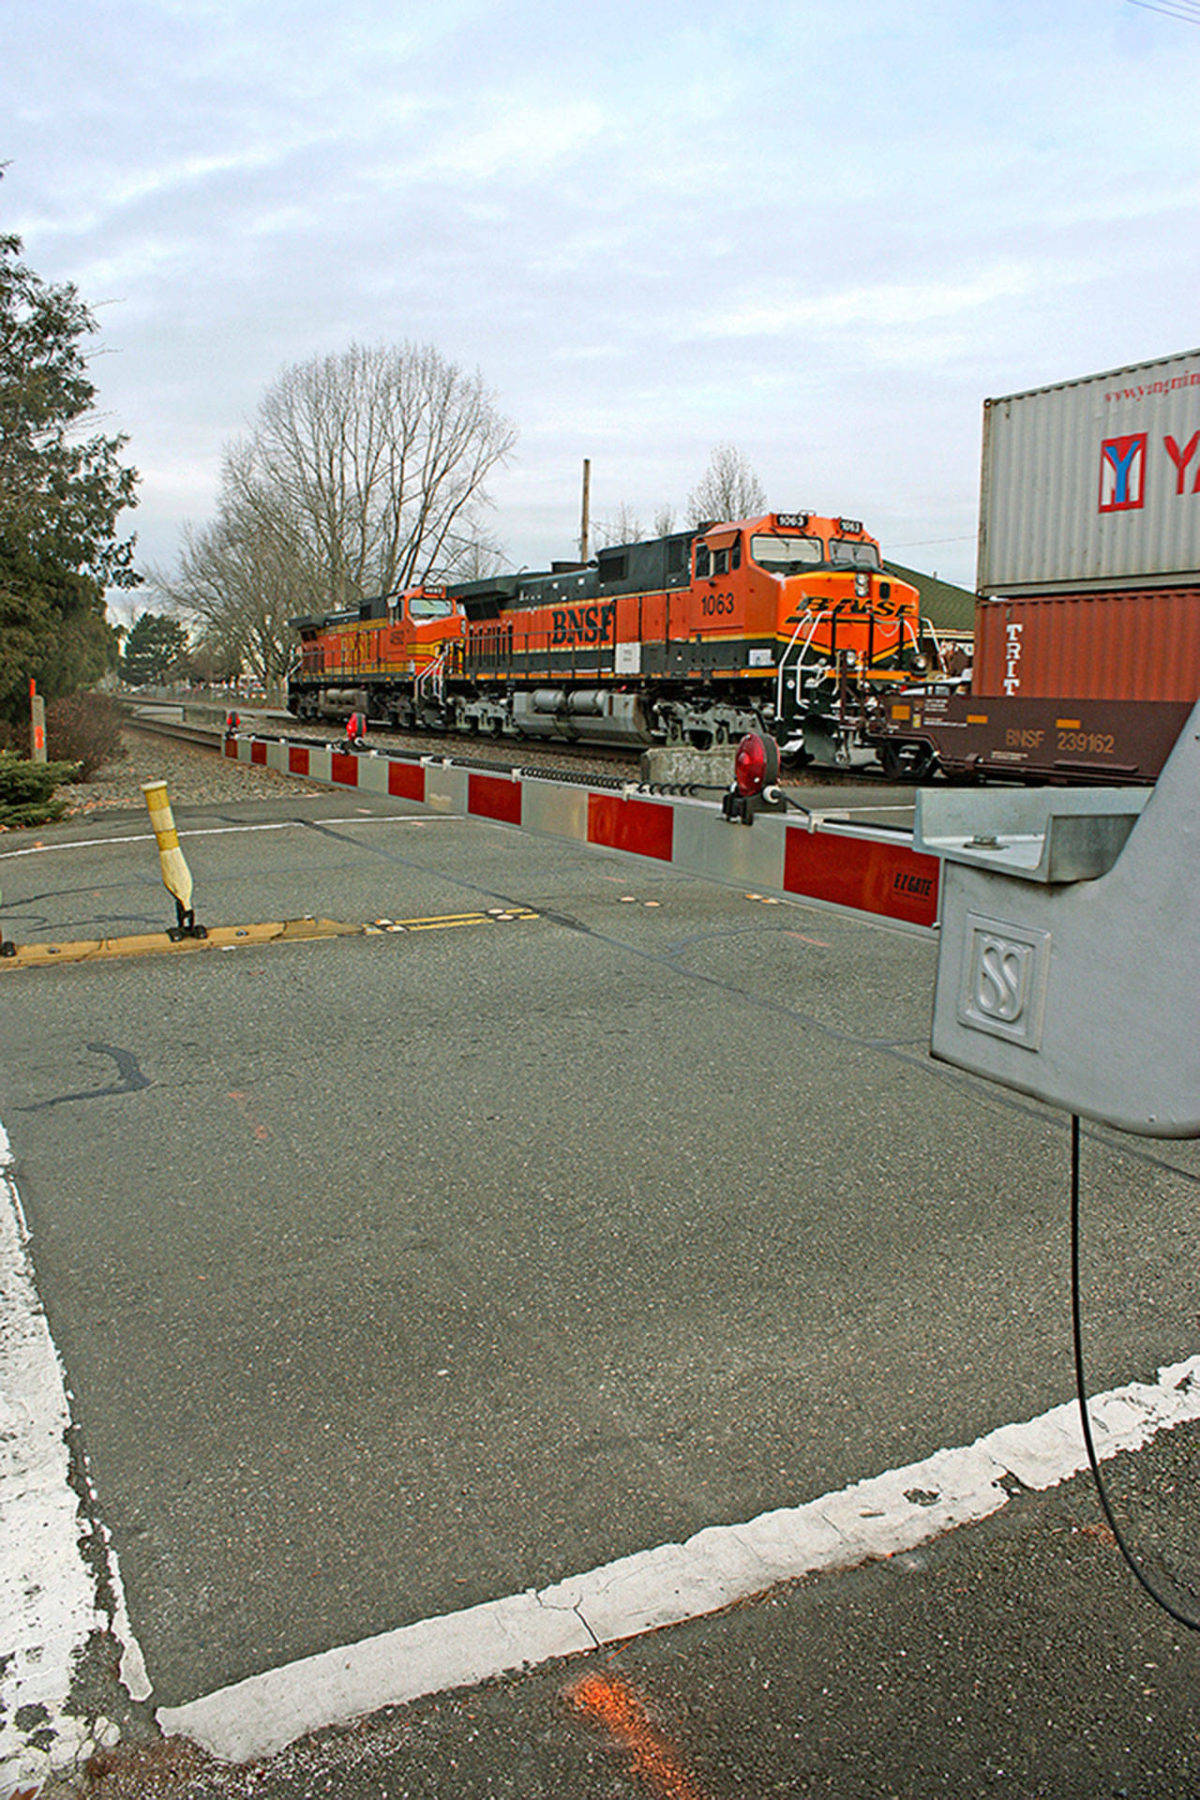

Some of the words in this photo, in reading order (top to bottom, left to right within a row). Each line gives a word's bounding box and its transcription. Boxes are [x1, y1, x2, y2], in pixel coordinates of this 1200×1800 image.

[778, 515, 804, 527] 1063
[841, 521, 861, 534] 1063
[701, 592, 734, 616] 1063
[796, 596, 916, 618] BNSF
[552, 604, 615, 644] BNSF
[1005, 729, 1045, 749] BNSF
[1057, 732, 1114, 754] 239162
